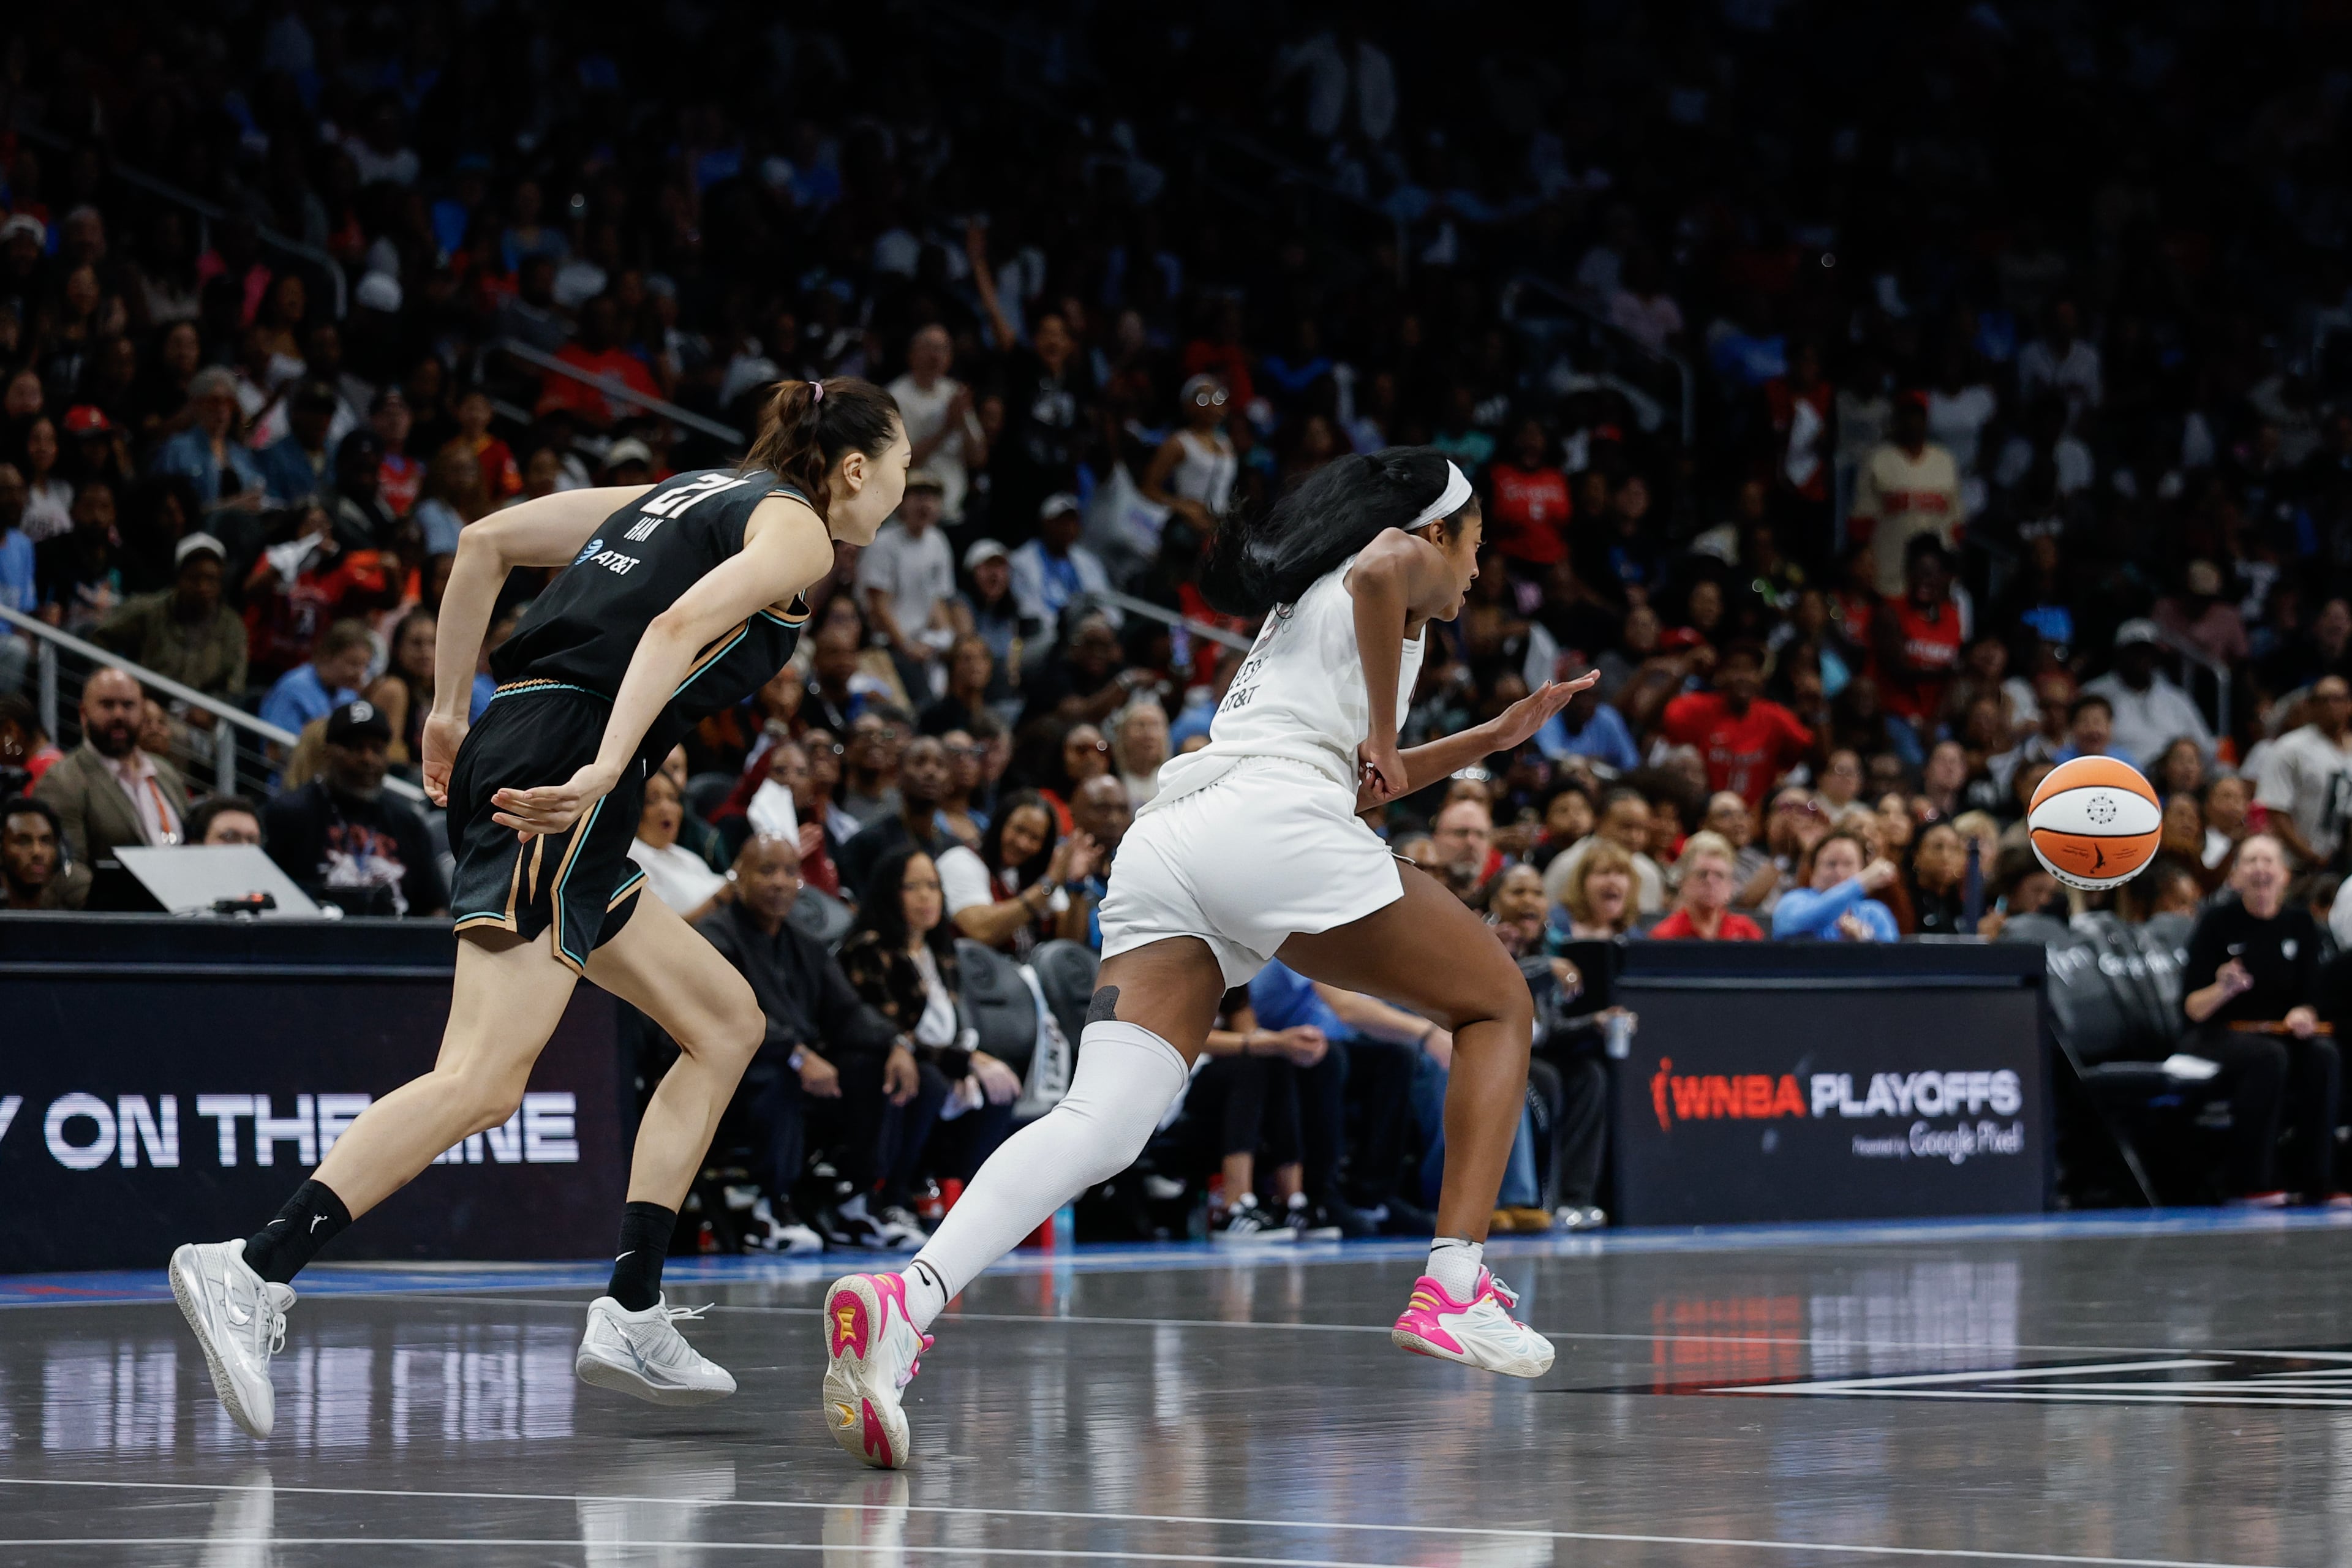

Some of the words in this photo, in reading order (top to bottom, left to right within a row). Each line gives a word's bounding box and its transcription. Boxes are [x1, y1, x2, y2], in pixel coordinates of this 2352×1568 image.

[639, 473, 751, 519] 21
[623, 516, 664, 542] HAN
[590, 550, 640, 575] AT&T
[1670, 1074, 1807, 1120] WNBA
[1810, 1069, 2023, 1118] PLAYOFFS
[43, 1092, 179, 1170] ON
[1909, 1120, 1977, 1164] Google
[1977, 1120, 2025, 1154] Pixel
